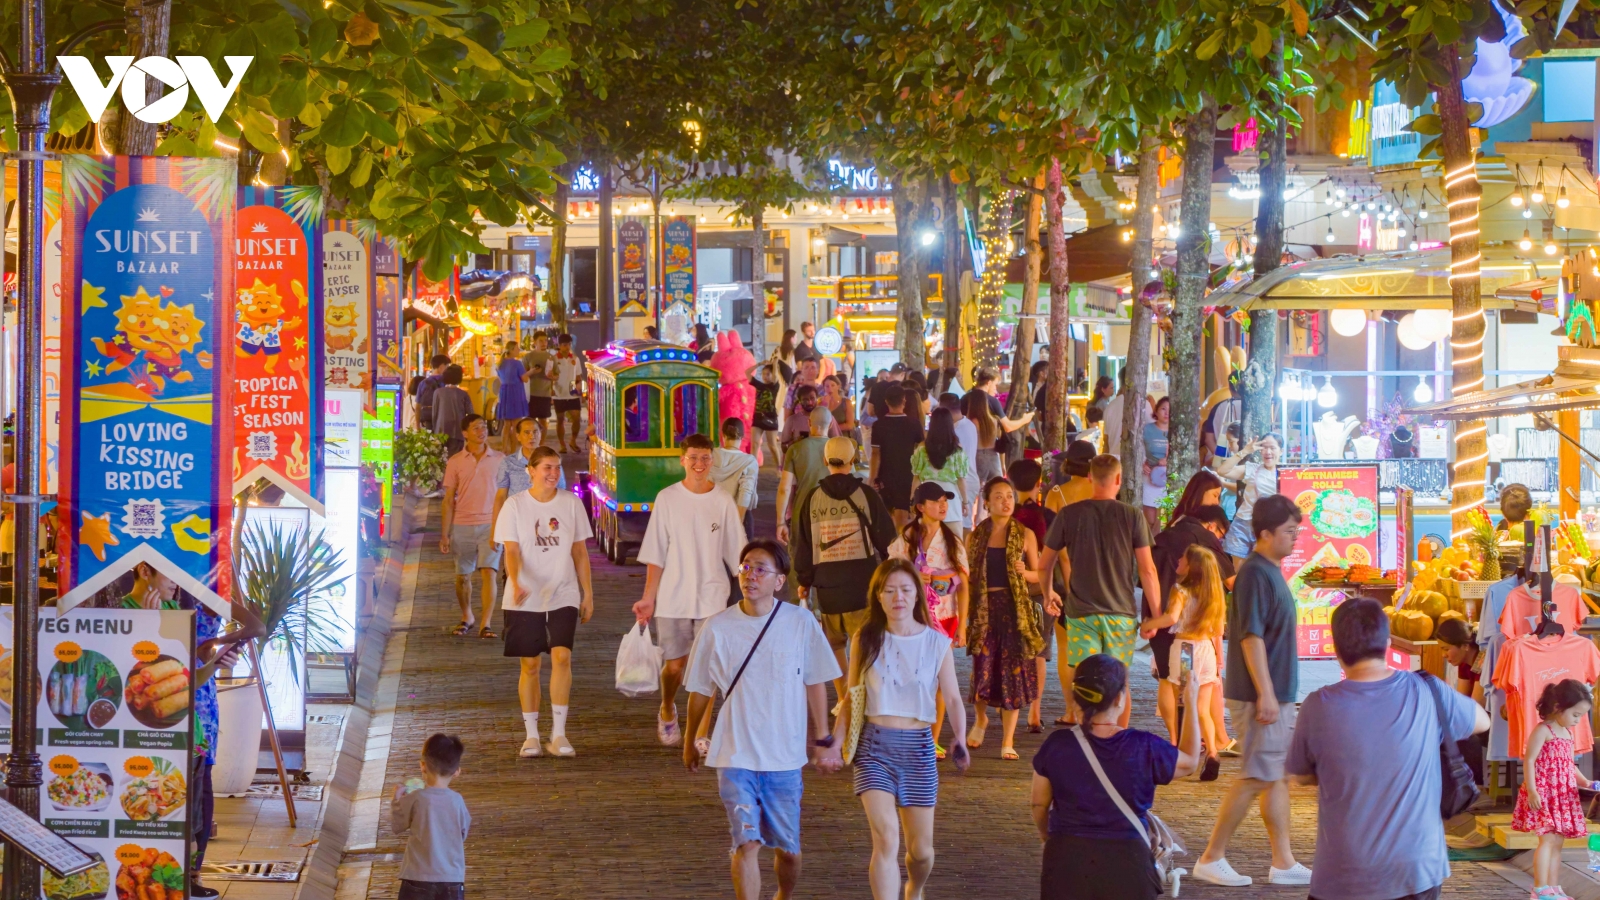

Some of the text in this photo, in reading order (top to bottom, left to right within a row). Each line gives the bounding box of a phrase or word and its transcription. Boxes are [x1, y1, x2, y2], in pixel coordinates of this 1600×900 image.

[95, 230, 201, 255] SUNSET
[236, 238, 298, 256] UNSET
[323, 251, 361, 261] UNSET
[117, 261, 179, 274] BAZAAR
[237, 261, 283, 270] BAZAAR
[328, 275, 350, 286] ERIC
[324, 356, 365, 367] ASTING
[251, 394, 292, 409] FEST
[243, 411, 304, 428] SEASON
[101, 422, 188, 442] LOVING
[99, 444, 194, 471] KISSING
[105, 471, 183, 490] BRIDGE
[1296, 471, 1359, 479] VIETNAMESE
[1312, 481, 1343, 489] ROLLS
[75, 619, 133, 634] MENU
